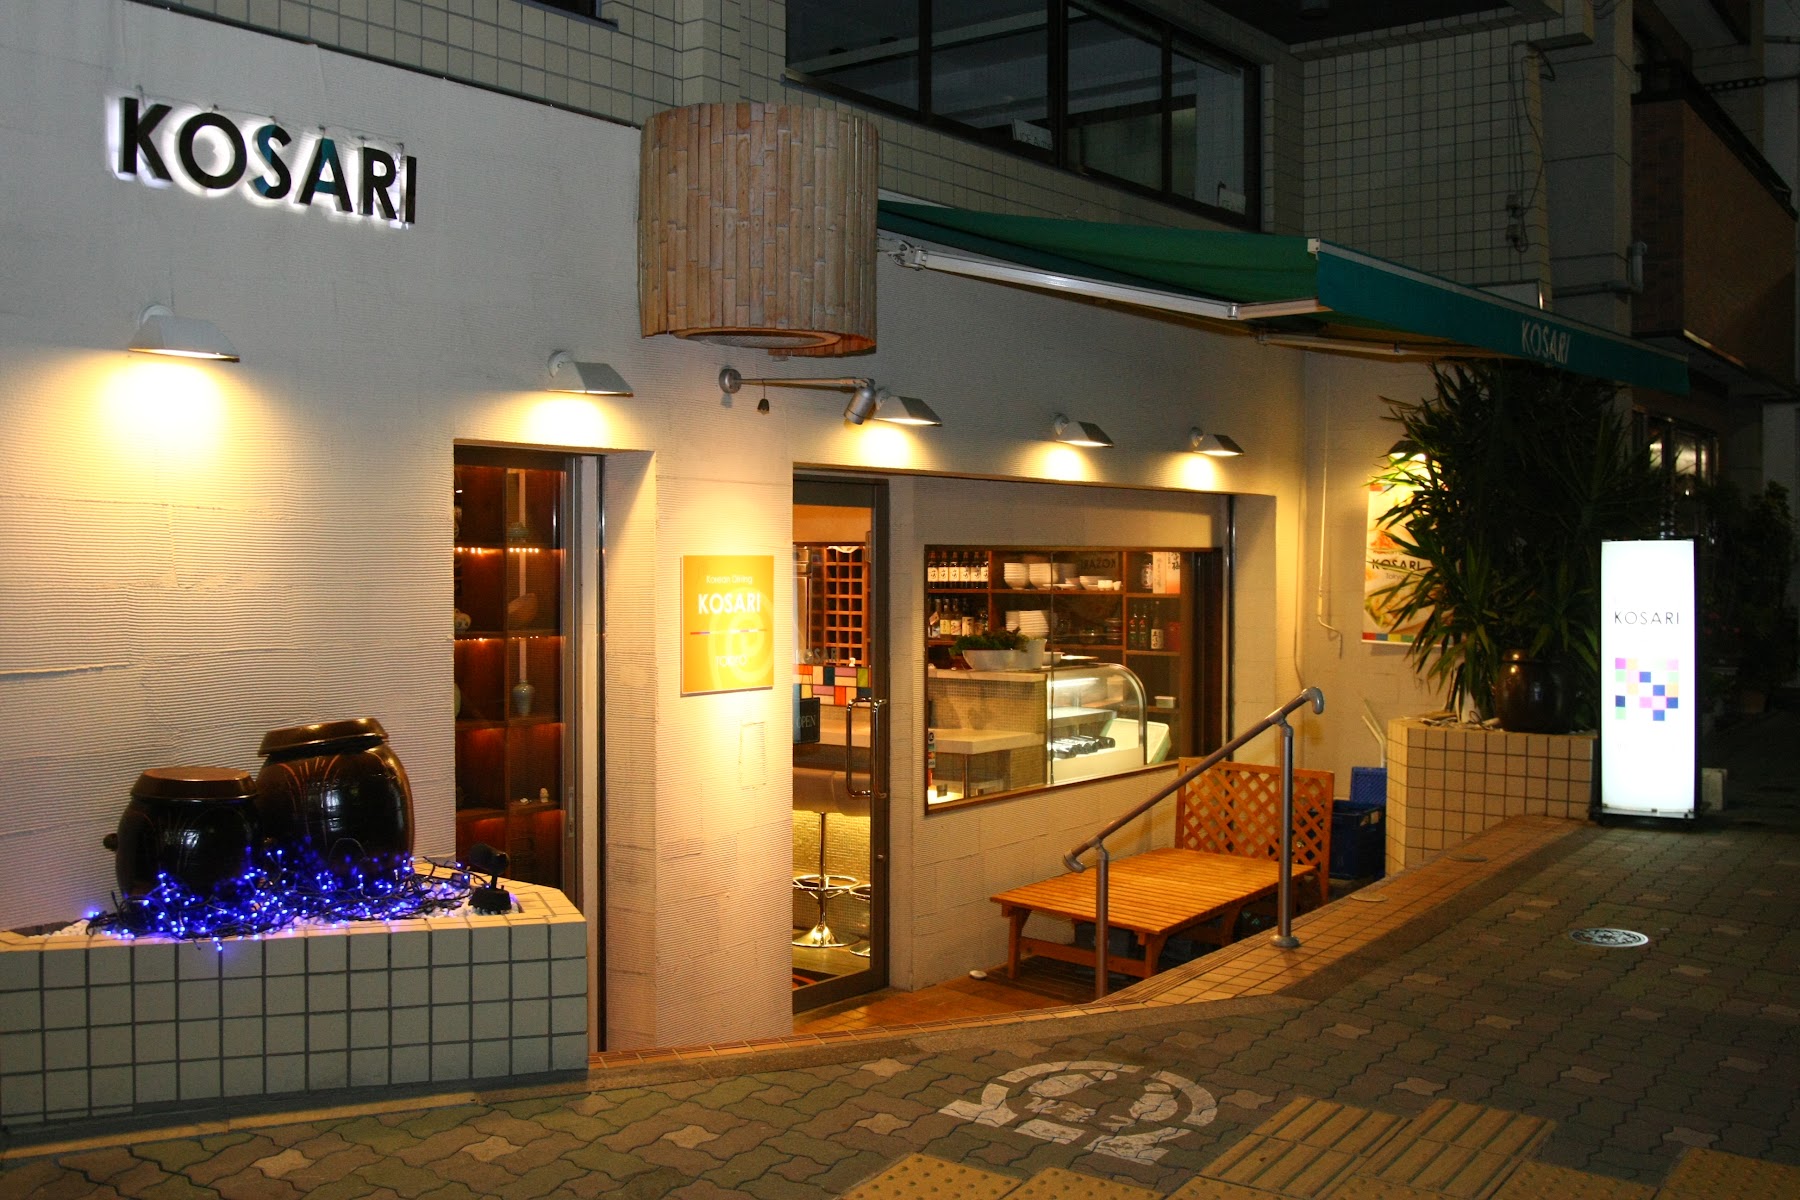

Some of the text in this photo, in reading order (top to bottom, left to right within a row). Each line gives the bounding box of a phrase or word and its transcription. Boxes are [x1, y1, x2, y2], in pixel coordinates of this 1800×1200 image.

[119, 96, 417, 224] KOSARI
[1521, 320, 1570, 364] KOSARI
[698, 592, 761, 615] KOSARI
[1614, 611, 1679, 625] KOSARI
[796, 714, 816, 729] OPEN
